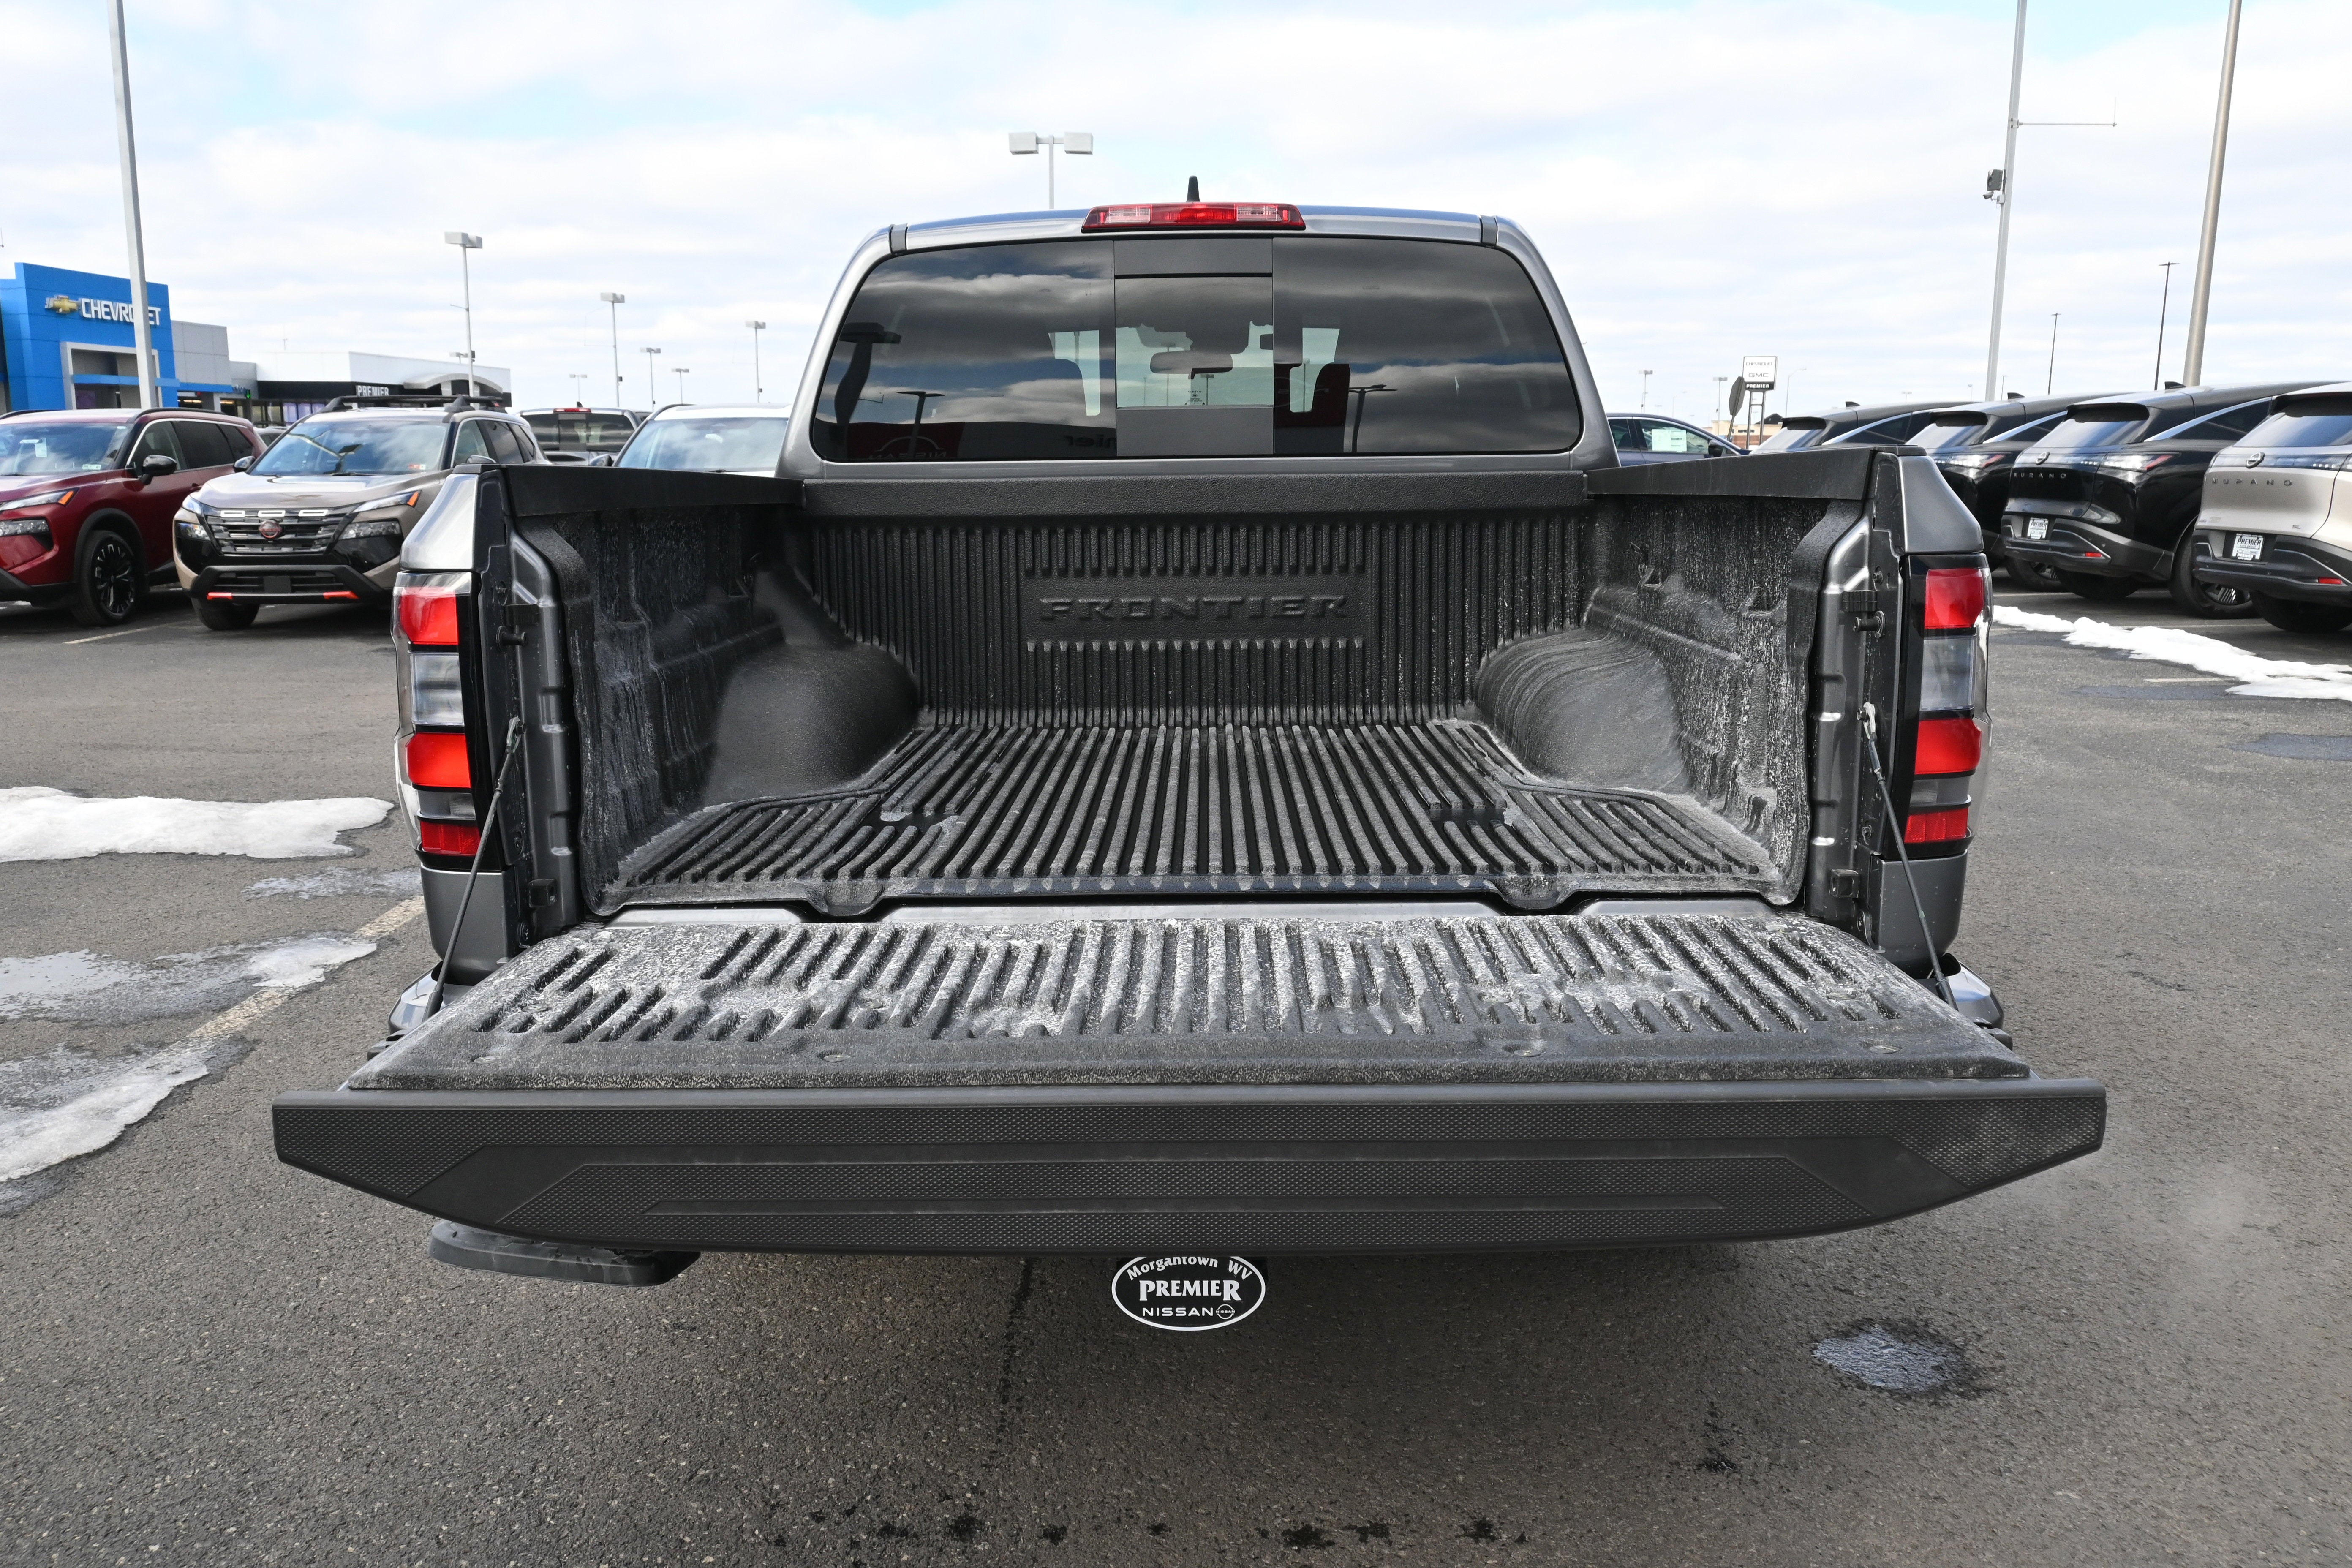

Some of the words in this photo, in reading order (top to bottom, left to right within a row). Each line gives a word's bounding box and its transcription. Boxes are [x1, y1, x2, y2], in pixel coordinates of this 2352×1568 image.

[82, 298, 161, 325] CHEVROET
[357, 385, 389, 396] PREMIER
[2212, 477, 2292, 486] MURANO
[2237, 538, 2262, 546] PREMIER
[1040, 596, 1348, 619] FRONTIER
[1127, 1256, 1218, 1280] Morgantown
[1227, 1260, 1253, 1280] WV
[1139, 1280, 1242, 1301] PREMIER
[1142, 1307, 1214, 1316] NISSAN
